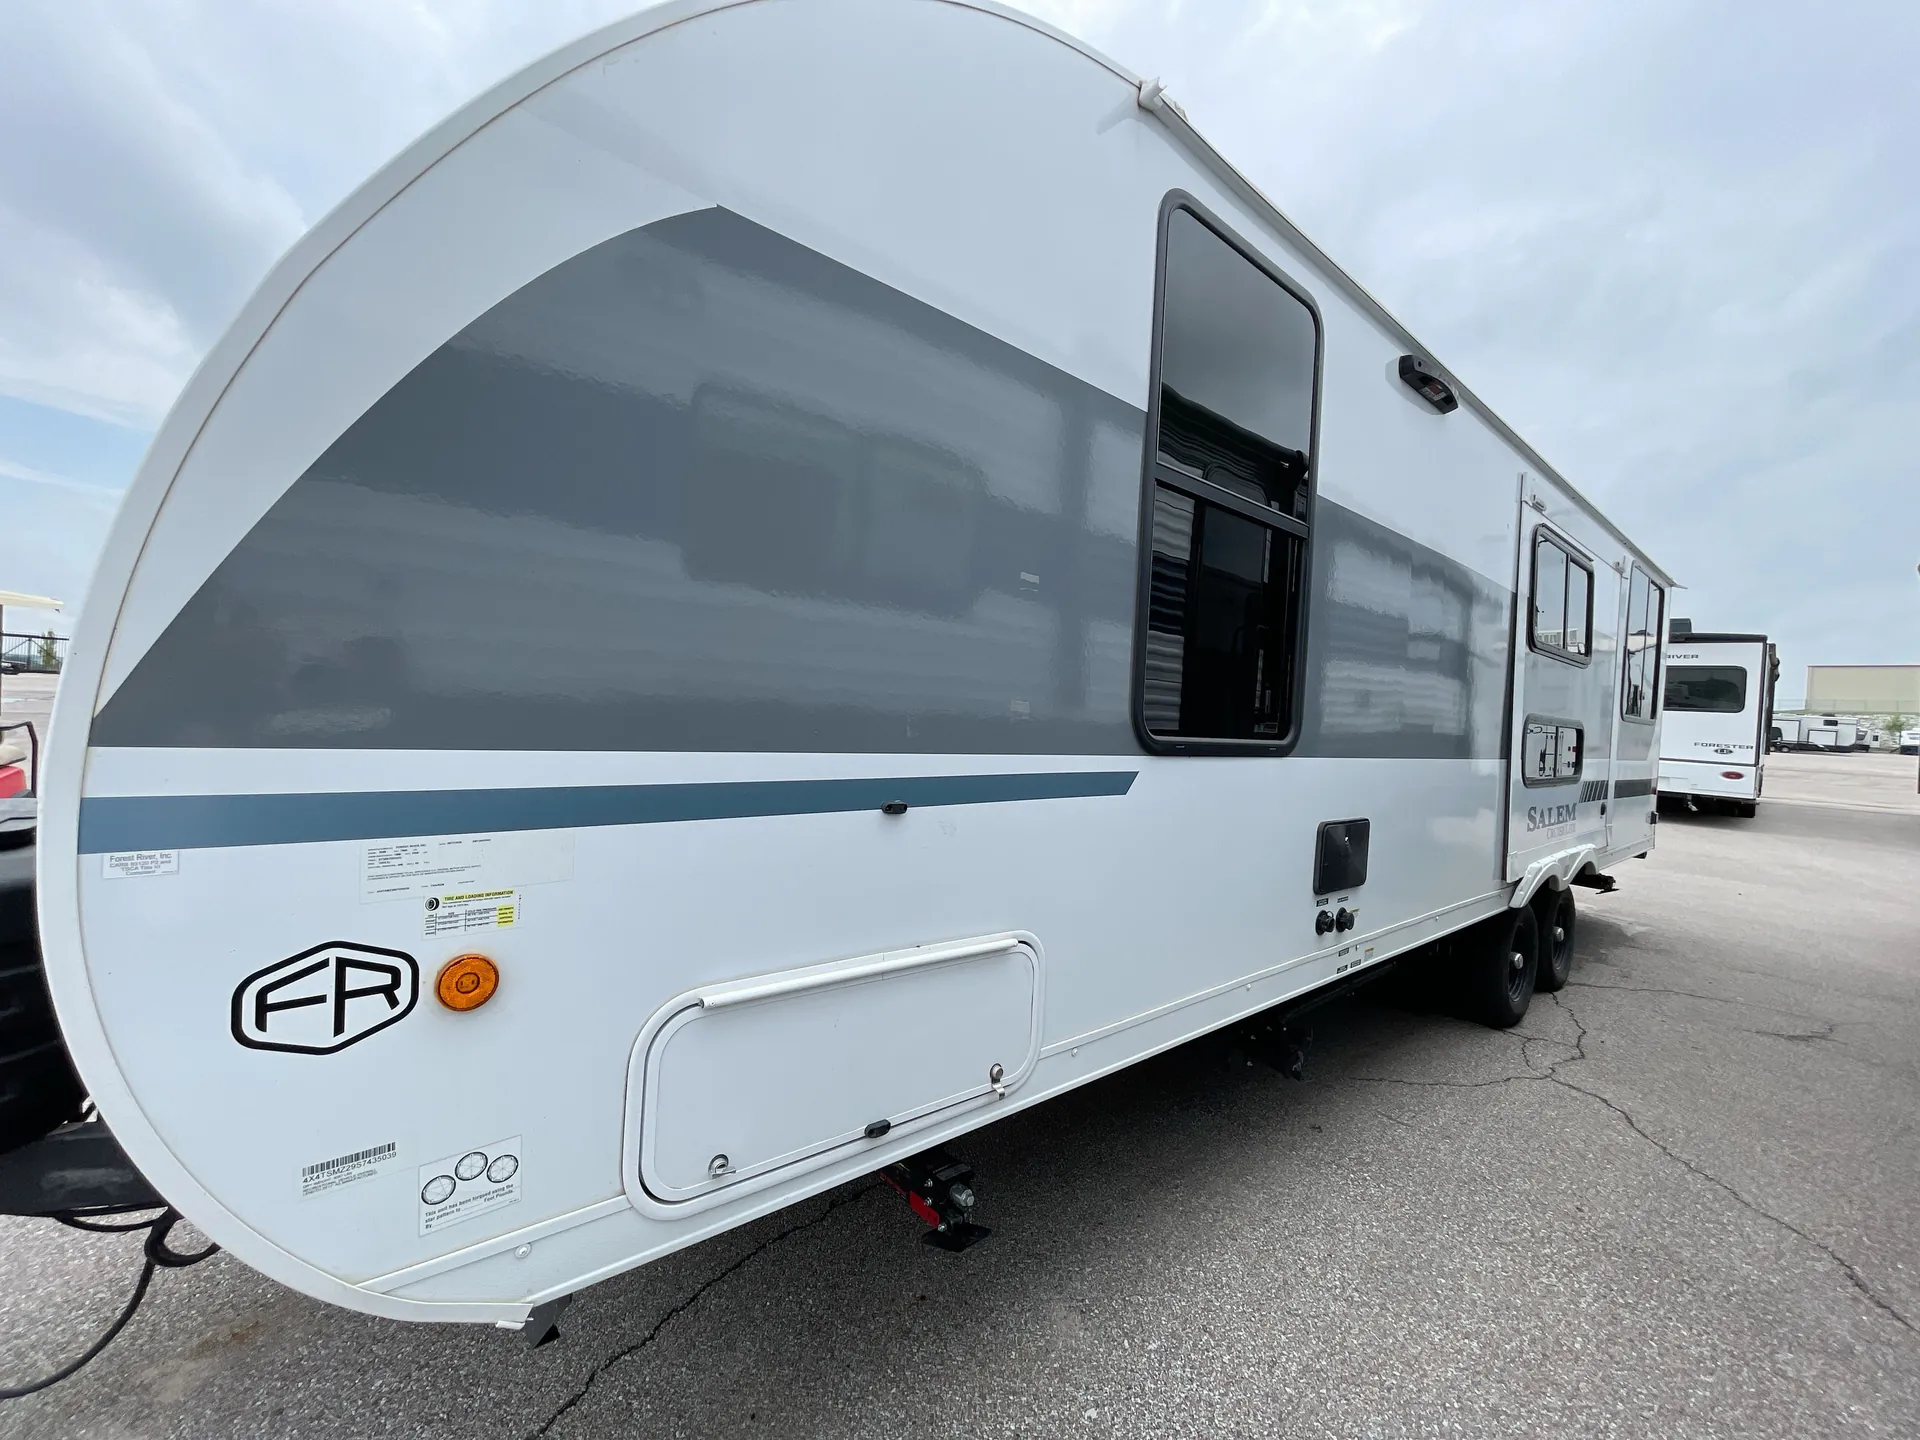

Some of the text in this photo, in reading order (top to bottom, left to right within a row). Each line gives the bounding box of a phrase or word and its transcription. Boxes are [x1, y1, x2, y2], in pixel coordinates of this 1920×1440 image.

[1693, 742, 1754, 750] FORESTER
[1527, 802, 1577, 832] SALEM
[302, 1151, 397, 1183] 4X4TSMZ29S7435039
